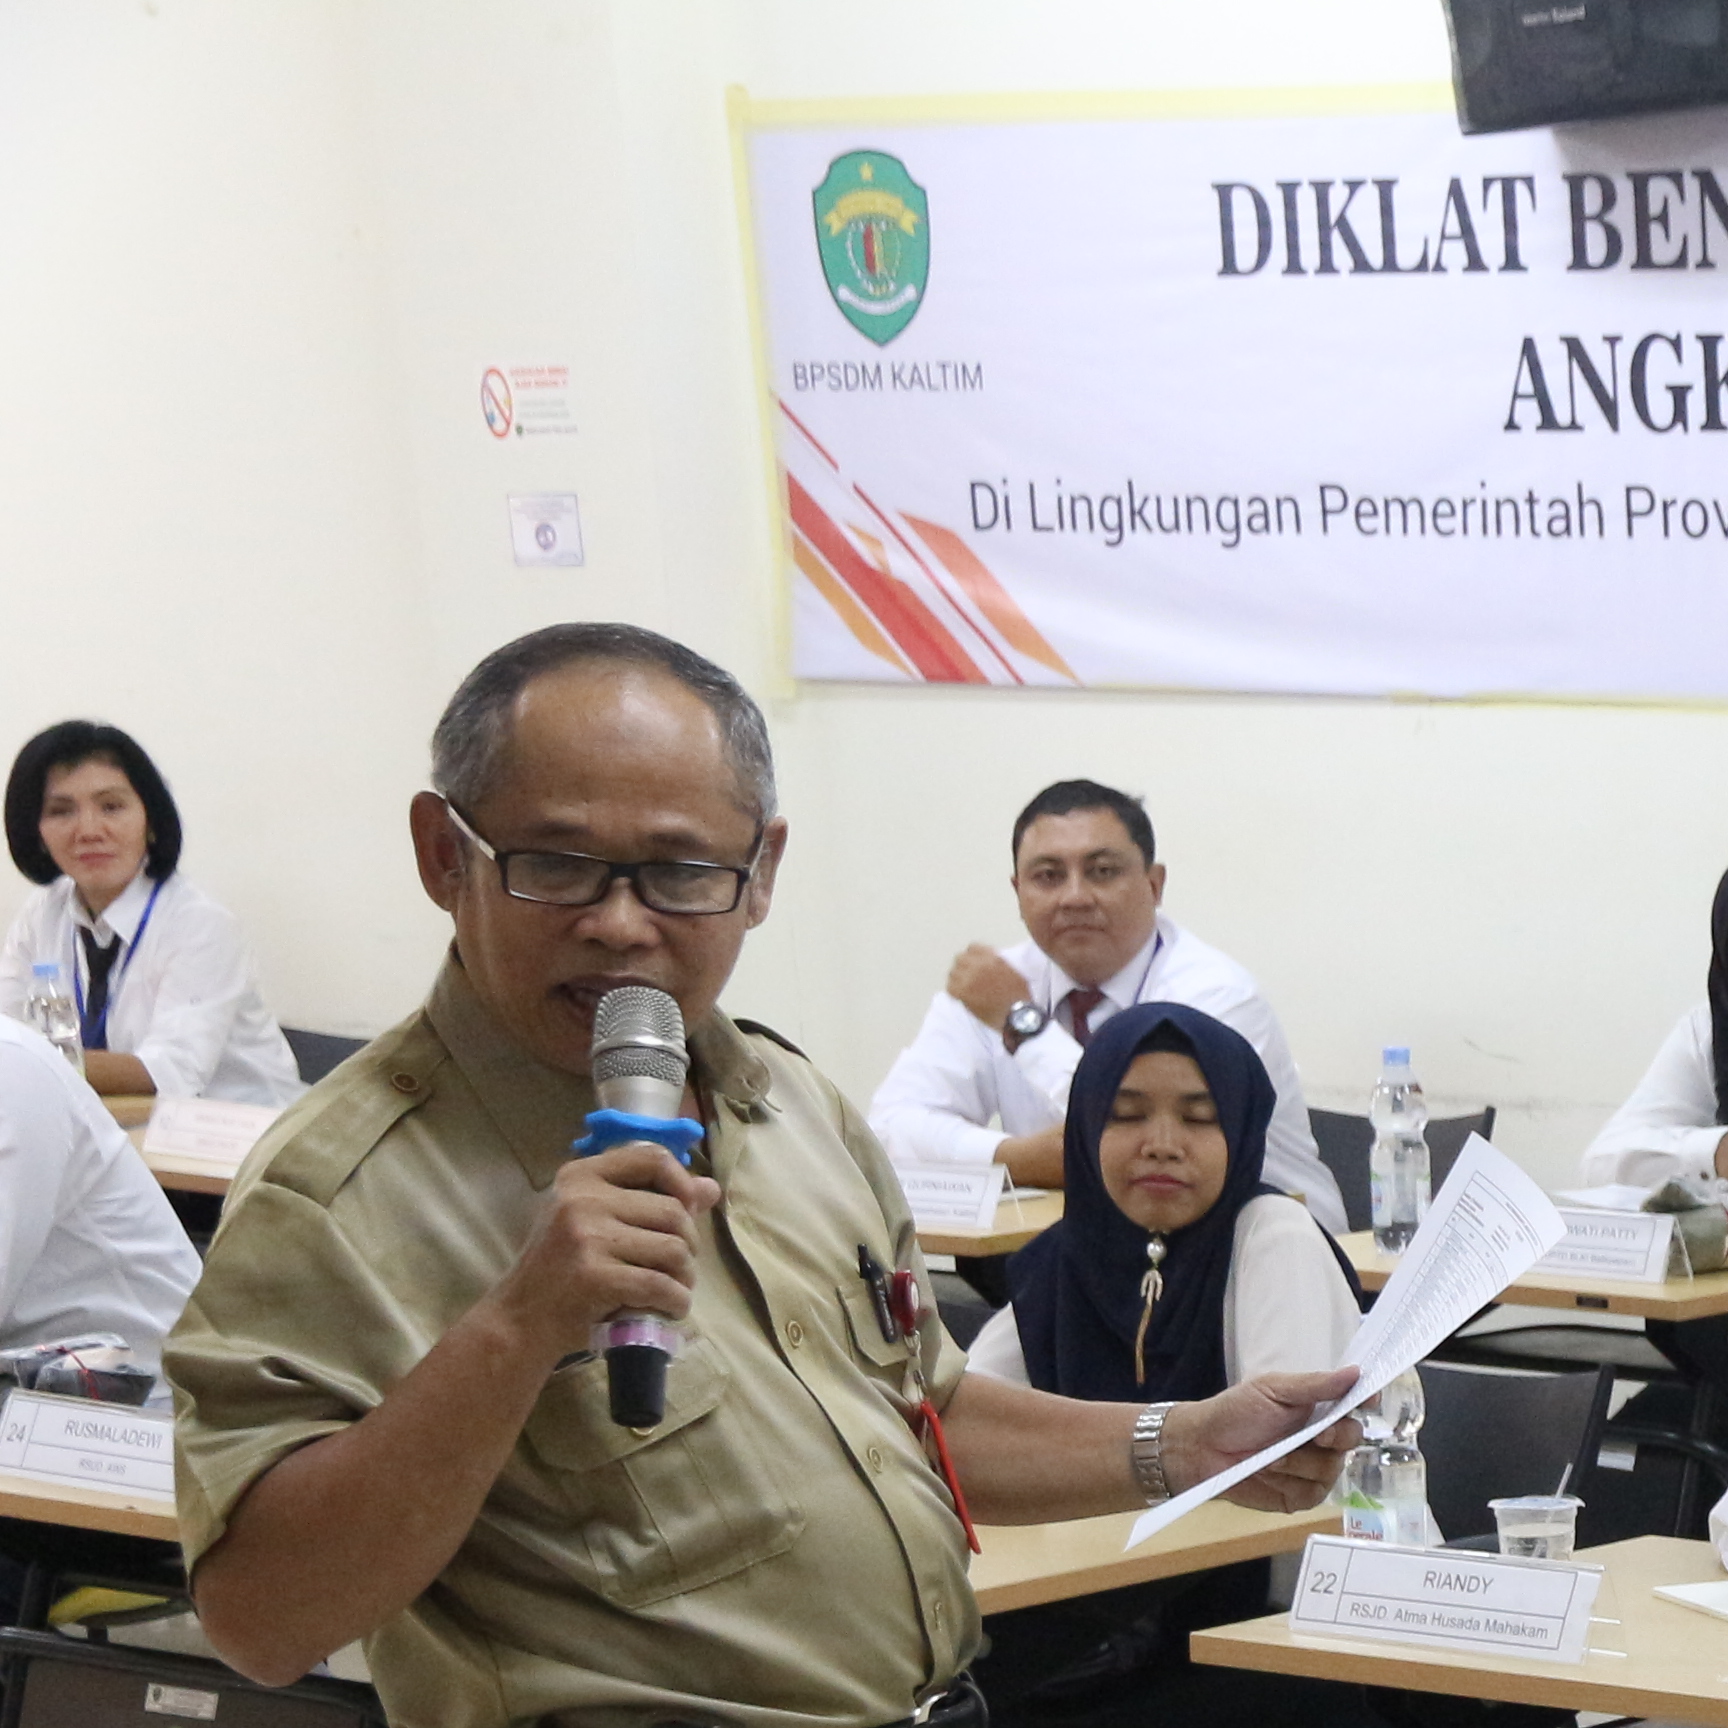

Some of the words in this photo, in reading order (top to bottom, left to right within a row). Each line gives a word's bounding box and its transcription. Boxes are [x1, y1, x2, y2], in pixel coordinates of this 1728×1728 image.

[1211, 176, 1536, 277] DIKLAT
[792, 361, 884, 392] BPSDM
[891, 361, 984, 392] KALTIM
[970, 479, 1012, 533] Di
[1028, 478, 1302, 549] Lingkungan
[1318, 480, 1605, 540] Pemerintah
[6, 1422, 27, 1443] 24
[64, 1418, 163, 1450] RUSMALADEWI
[1309, 1571, 1339, 1596] 22
[1422, 1569, 1495, 1596] RIANDY
[1393, 1607, 1428, 1627] Atma
[1430, 1612, 1483, 1633] Husada
[1484, 1617, 1550, 1640] Mahakam
